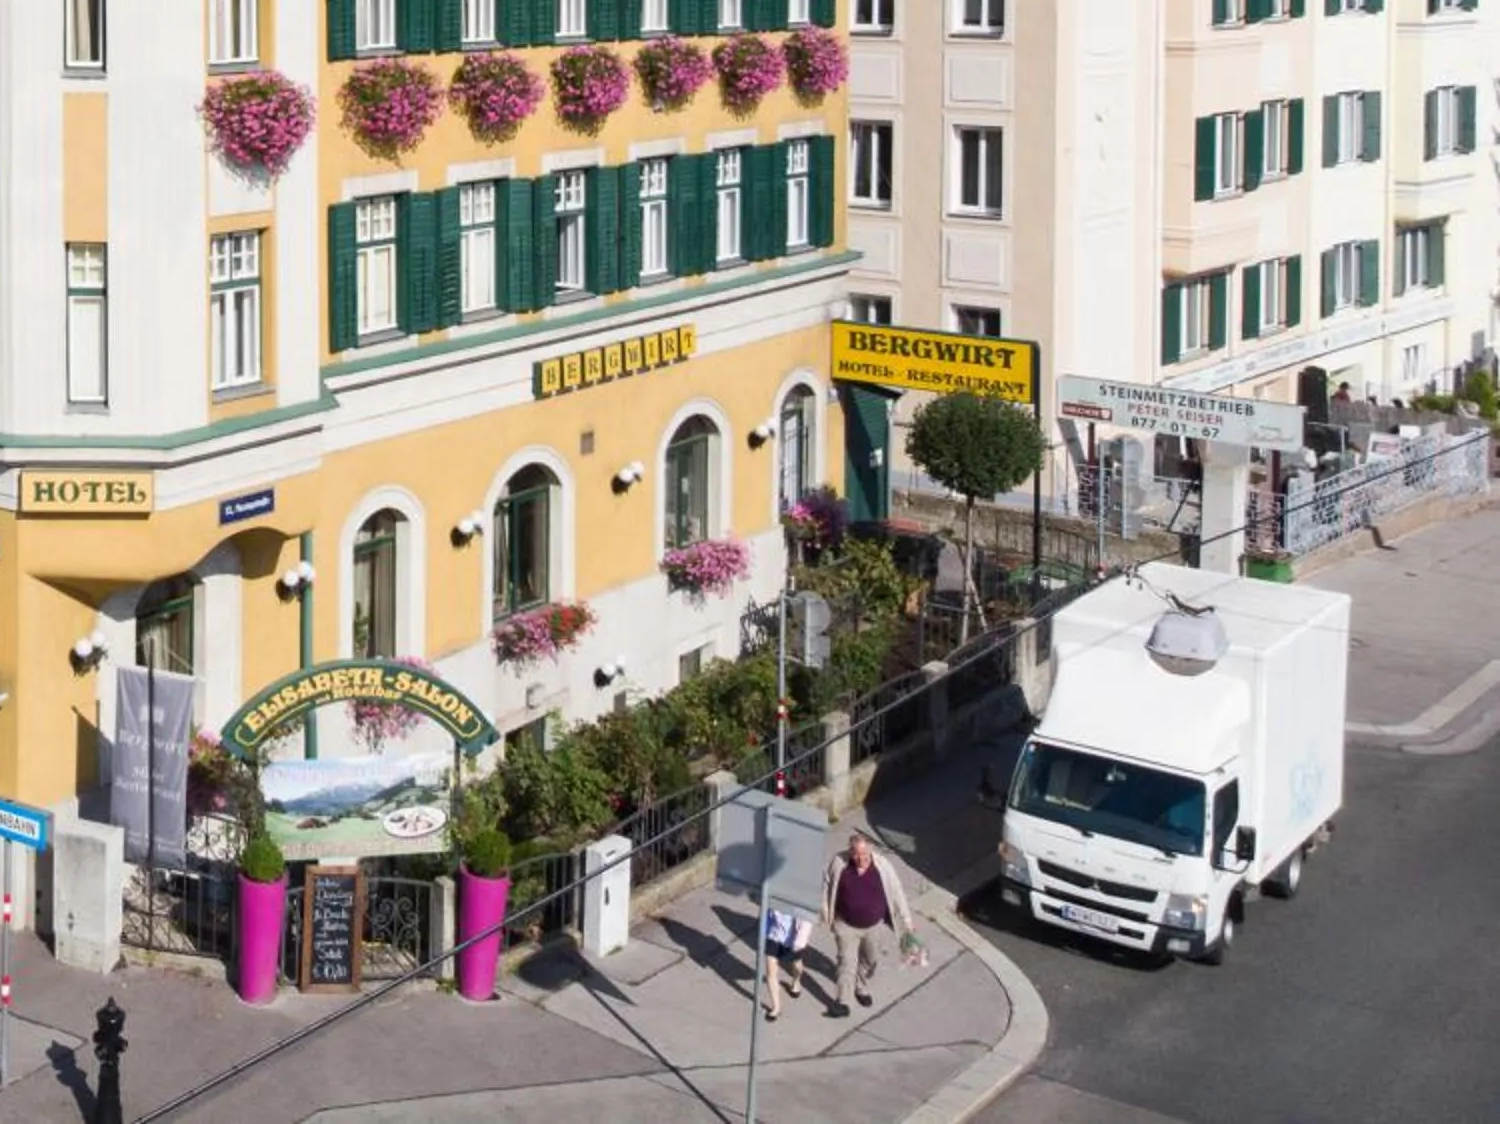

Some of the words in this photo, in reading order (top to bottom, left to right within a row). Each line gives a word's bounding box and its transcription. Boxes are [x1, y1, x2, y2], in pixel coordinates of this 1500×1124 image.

[545, 331, 694, 386] BERGWIRT
[847, 330, 1016, 370] BERGWIRT
[838, 359, 894, 377] HOTEL
[906, 369, 1027, 395] RESTAURANT
[1099, 384, 1256, 417] STEINMETZBETRIEB
[1127, 403, 1170, 418] PETER
[32, 480, 148, 504] HOTEL
